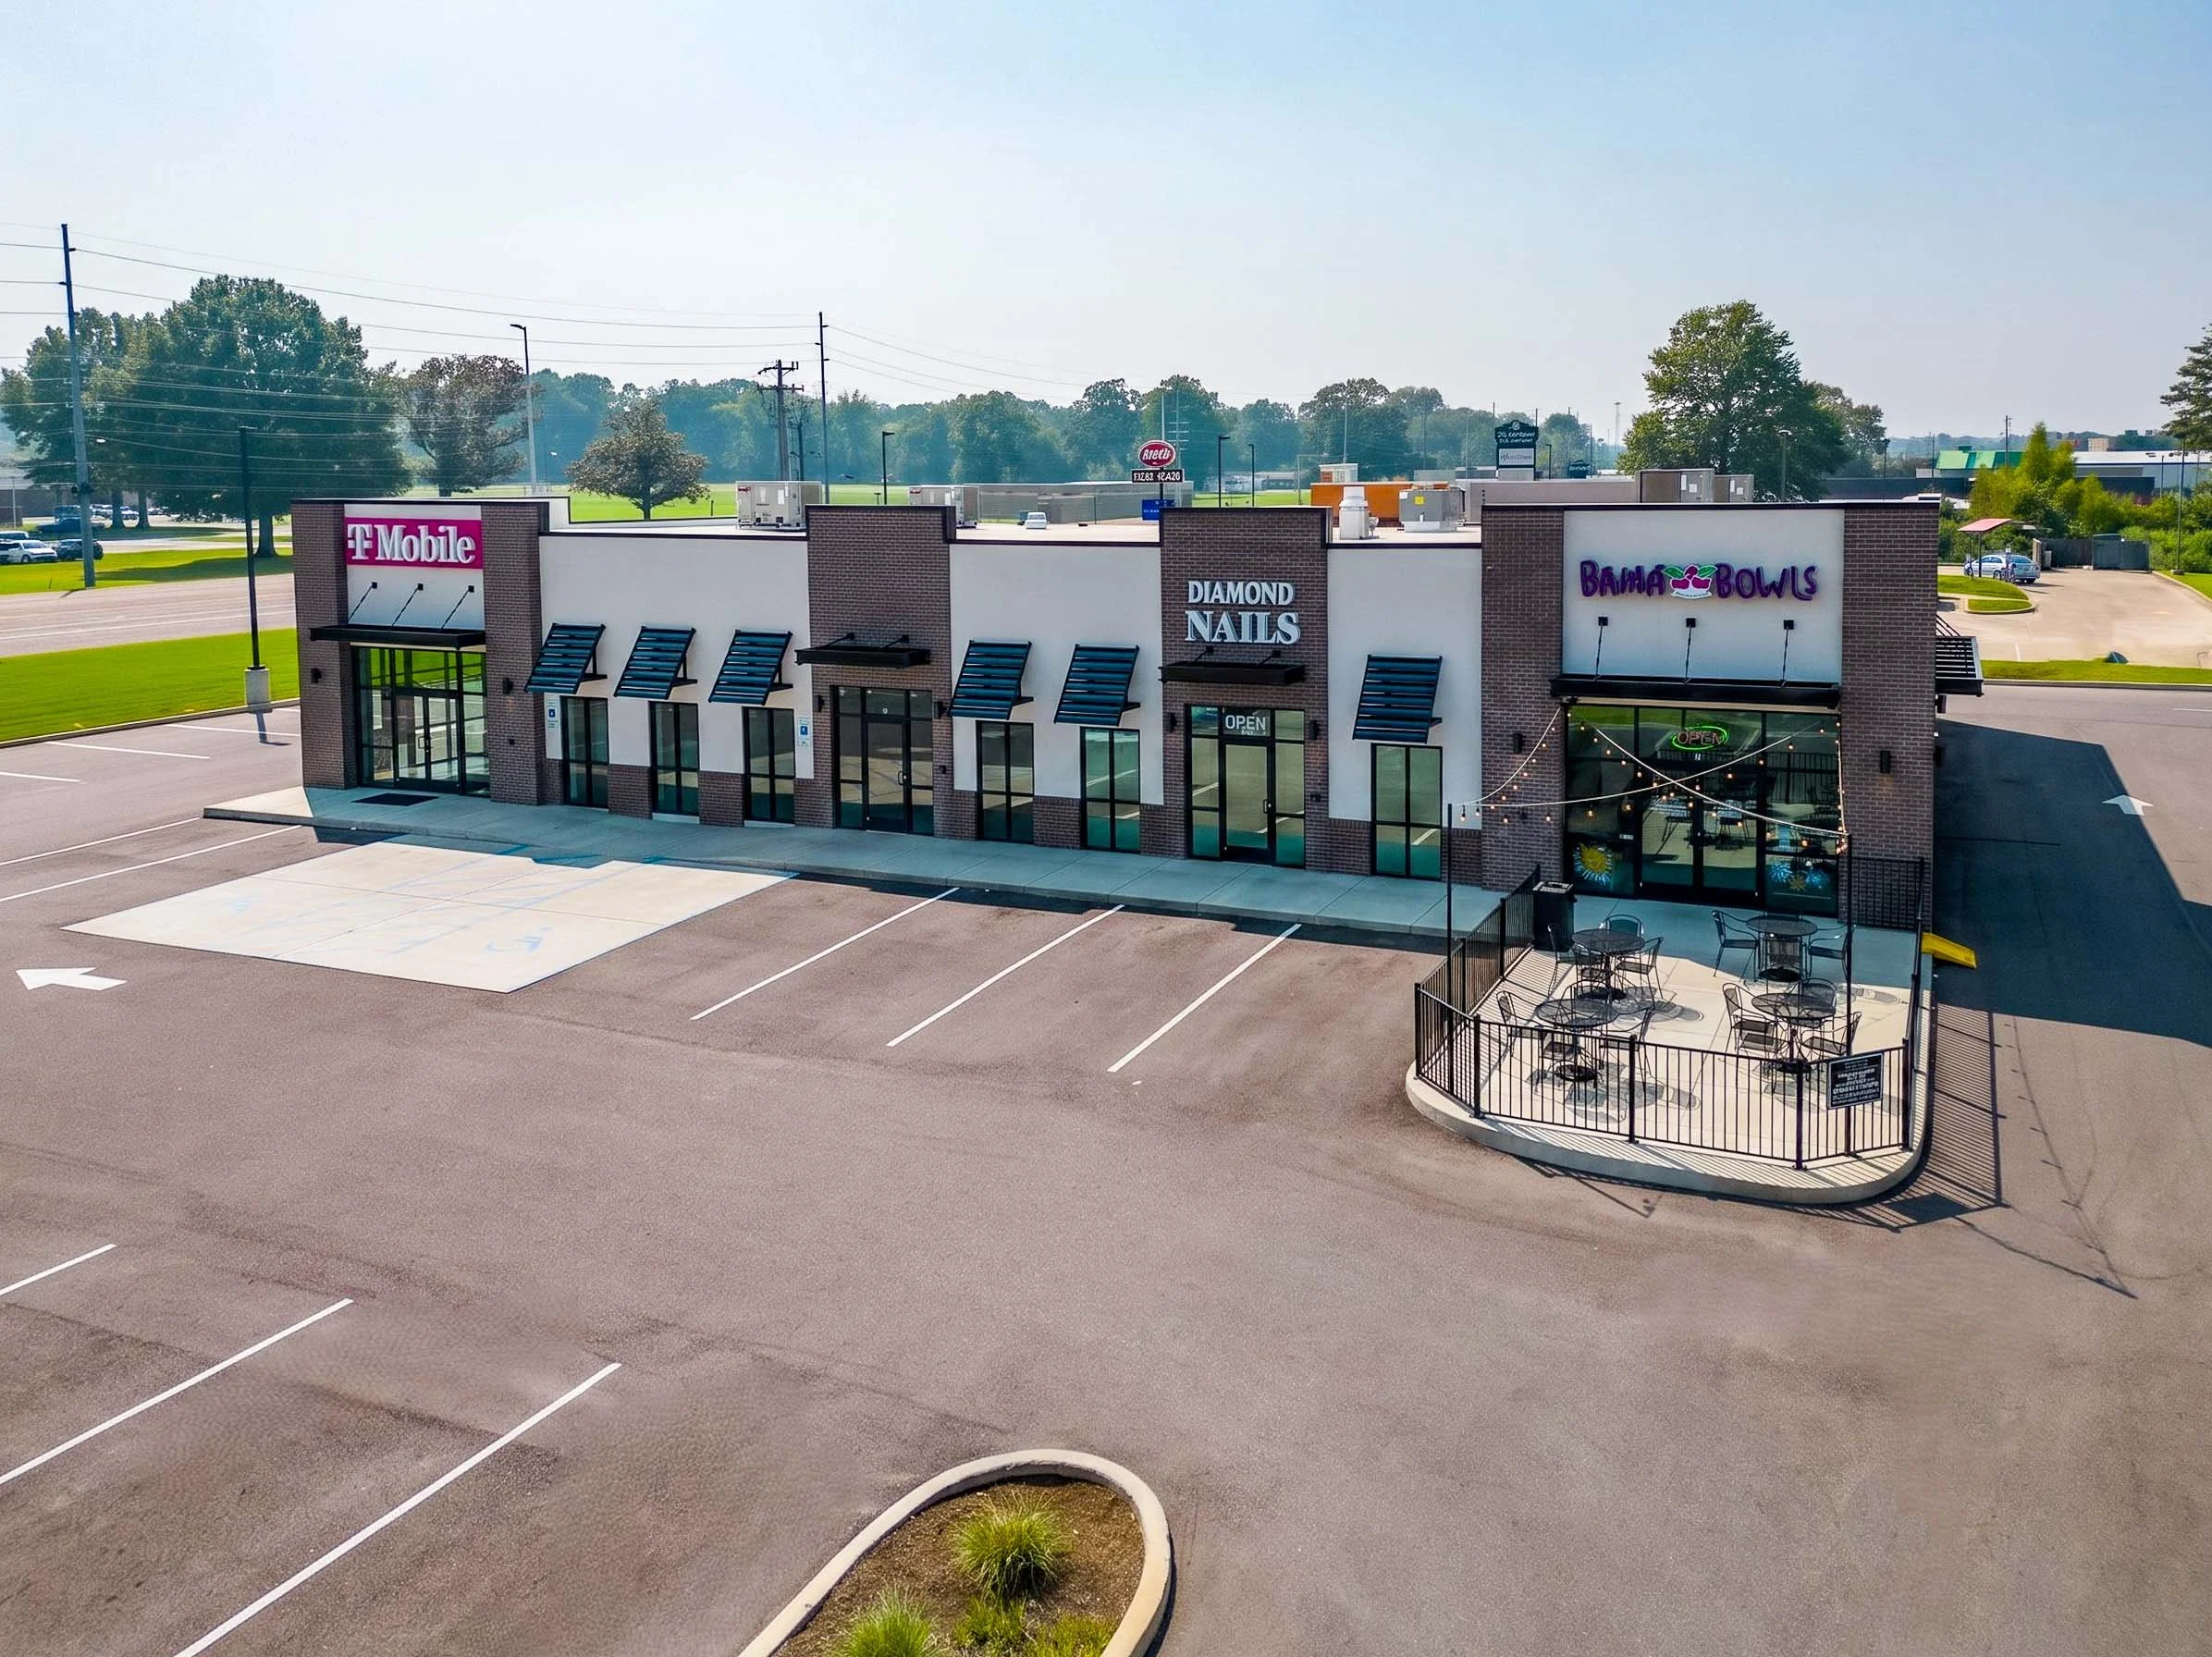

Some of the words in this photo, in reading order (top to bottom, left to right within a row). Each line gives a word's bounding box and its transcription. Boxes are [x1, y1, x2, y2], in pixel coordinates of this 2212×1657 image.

[1579, 559, 1665, 597] BAMA
[1714, 563, 1819, 602] BOWLS
[1187, 581, 1295, 606] DIAMOND
[1185, 610, 1301, 644] NAILS
[1225, 715, 1266, 730] OPEN
[1677, 730, 1723, 745] OPEN
